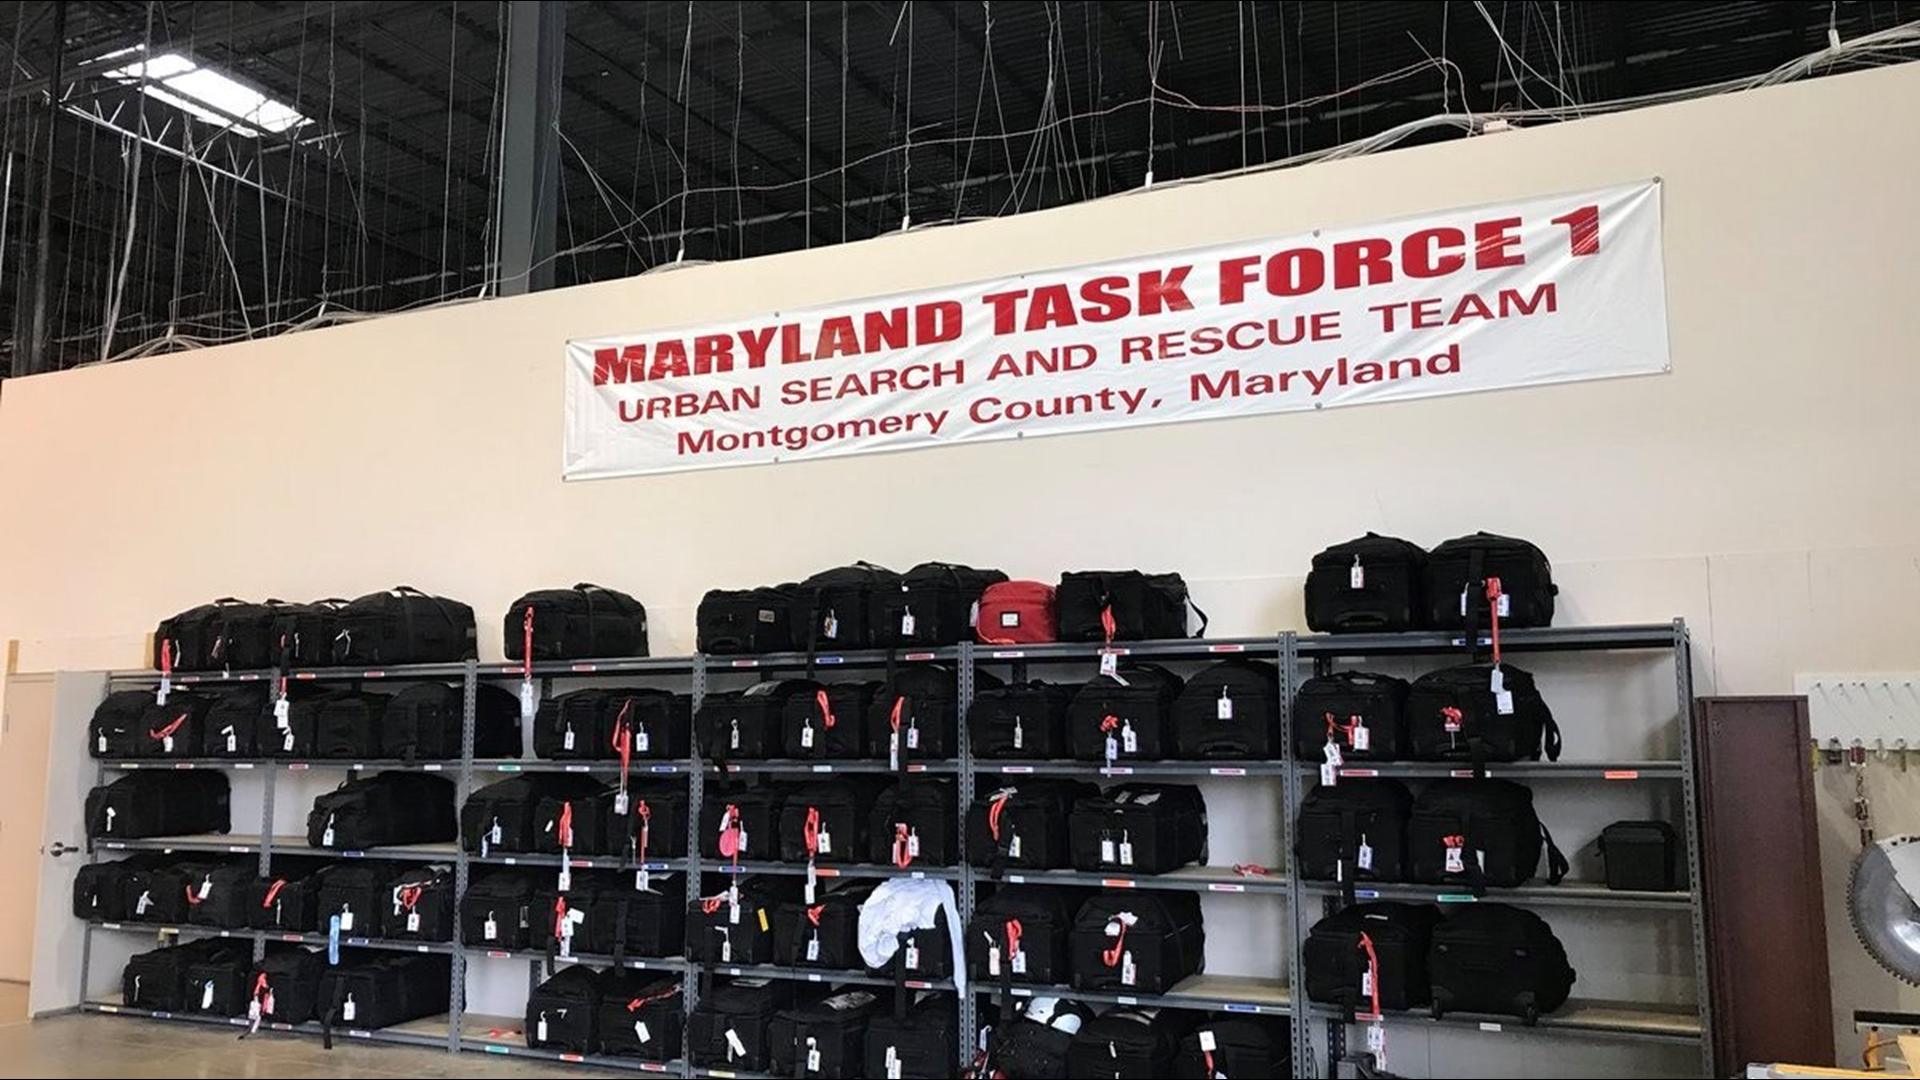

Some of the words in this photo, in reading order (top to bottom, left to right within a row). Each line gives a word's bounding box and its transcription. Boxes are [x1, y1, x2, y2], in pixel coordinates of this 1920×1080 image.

[592, 299, 964, 387] MARYLAND
[982, 264, 1194, 336] TASK
[1218, 216, 1526, 306] FORCE
[1551, 205, 1600, 258] 1
[617, 386, 760, 424] URBAN
[781, 360, 965, 405] SEARCH
[987, 343, 1098, 380] AND
[1121, 311, 1342, 364] RESCUE
[1369, 282, 1558, 335] TEAM
[677, 409, 949, 456] Montgomery
[968, 385, 1162, 425] County,
[1189, 343, 1462, 401] Maryland
